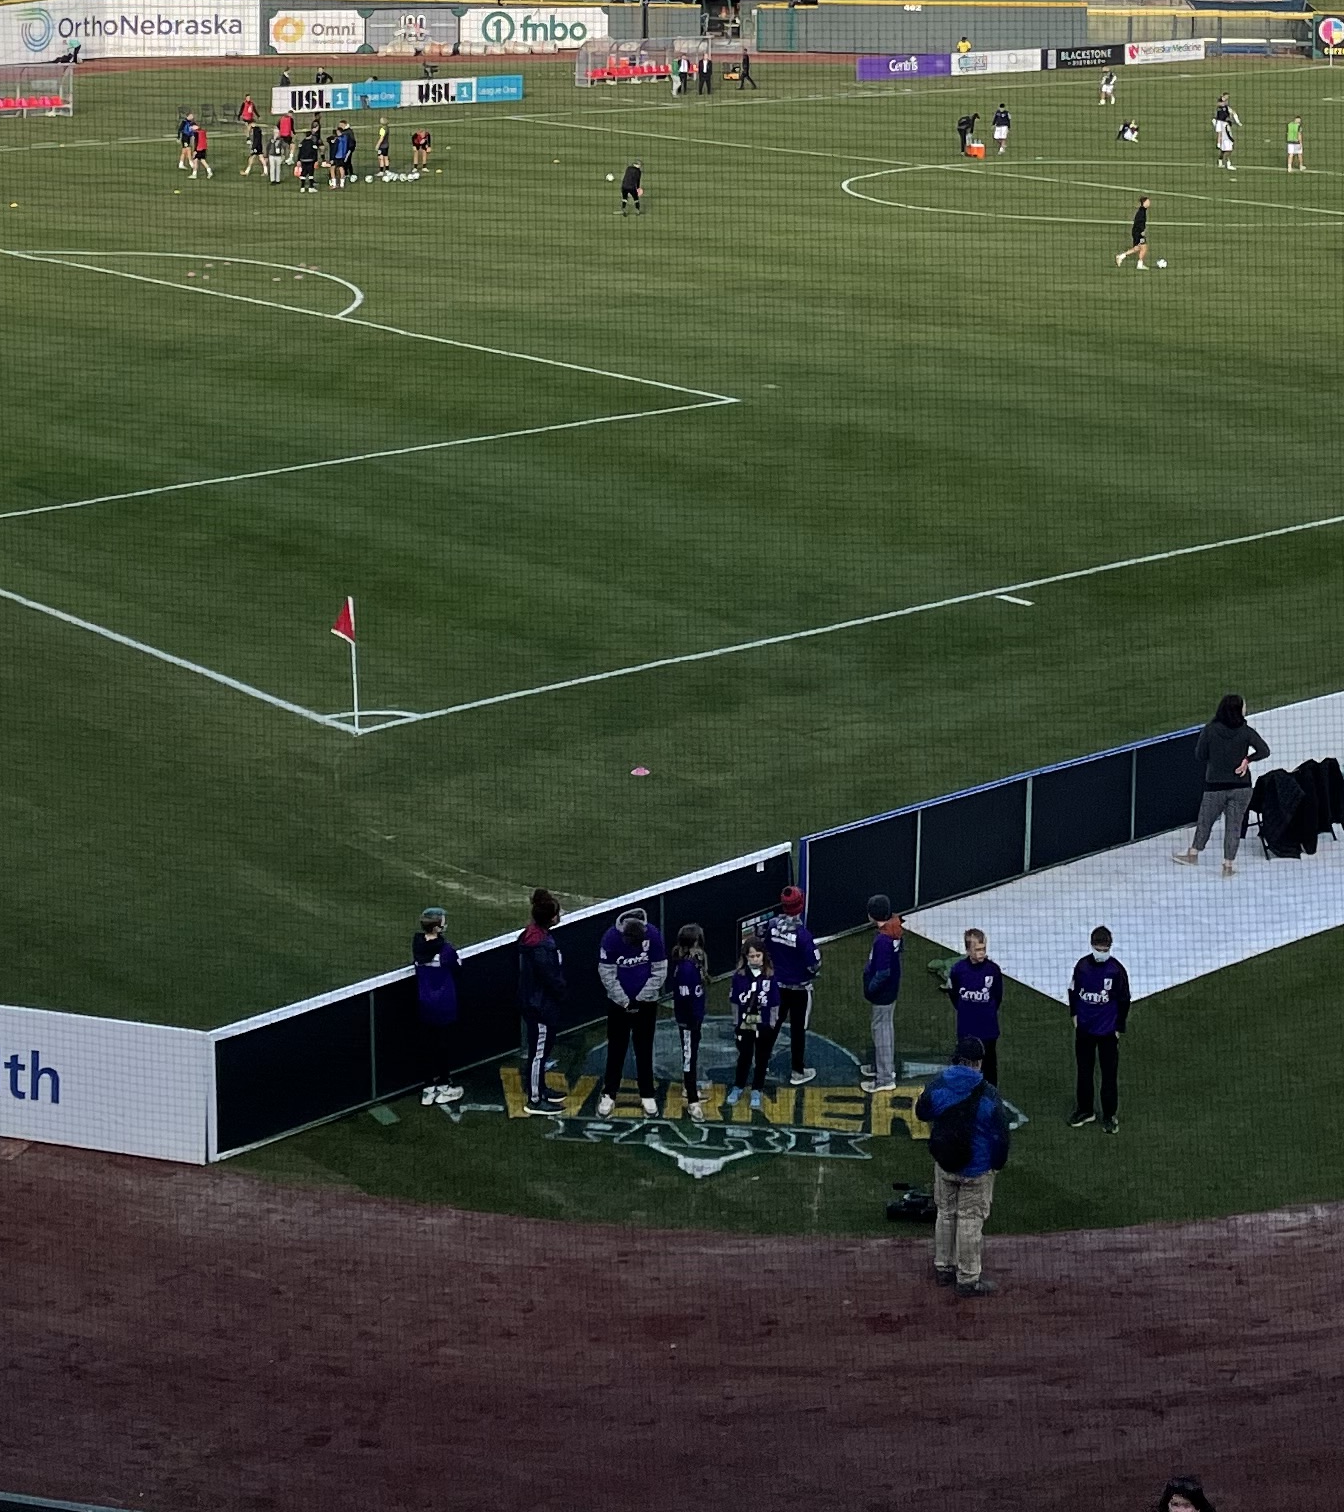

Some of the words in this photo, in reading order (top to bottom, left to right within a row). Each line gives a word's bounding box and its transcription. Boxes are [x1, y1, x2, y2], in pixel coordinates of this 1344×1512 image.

[58, 14, 243, 39] OrthoNebraska
[311, 22, 356, 36] Omni
[520, 14, 588, 42] fnbo
[1060, 47, 1113, 61] BLACKSTONE
[888, 56, 919, 73] Centris
[290, 89, 330, 111] USL
[958, 987, 991, 1003] Centris
[1078, 989, 1110, 1004] Centris
[545, 1115, 873, 1159] PARK
